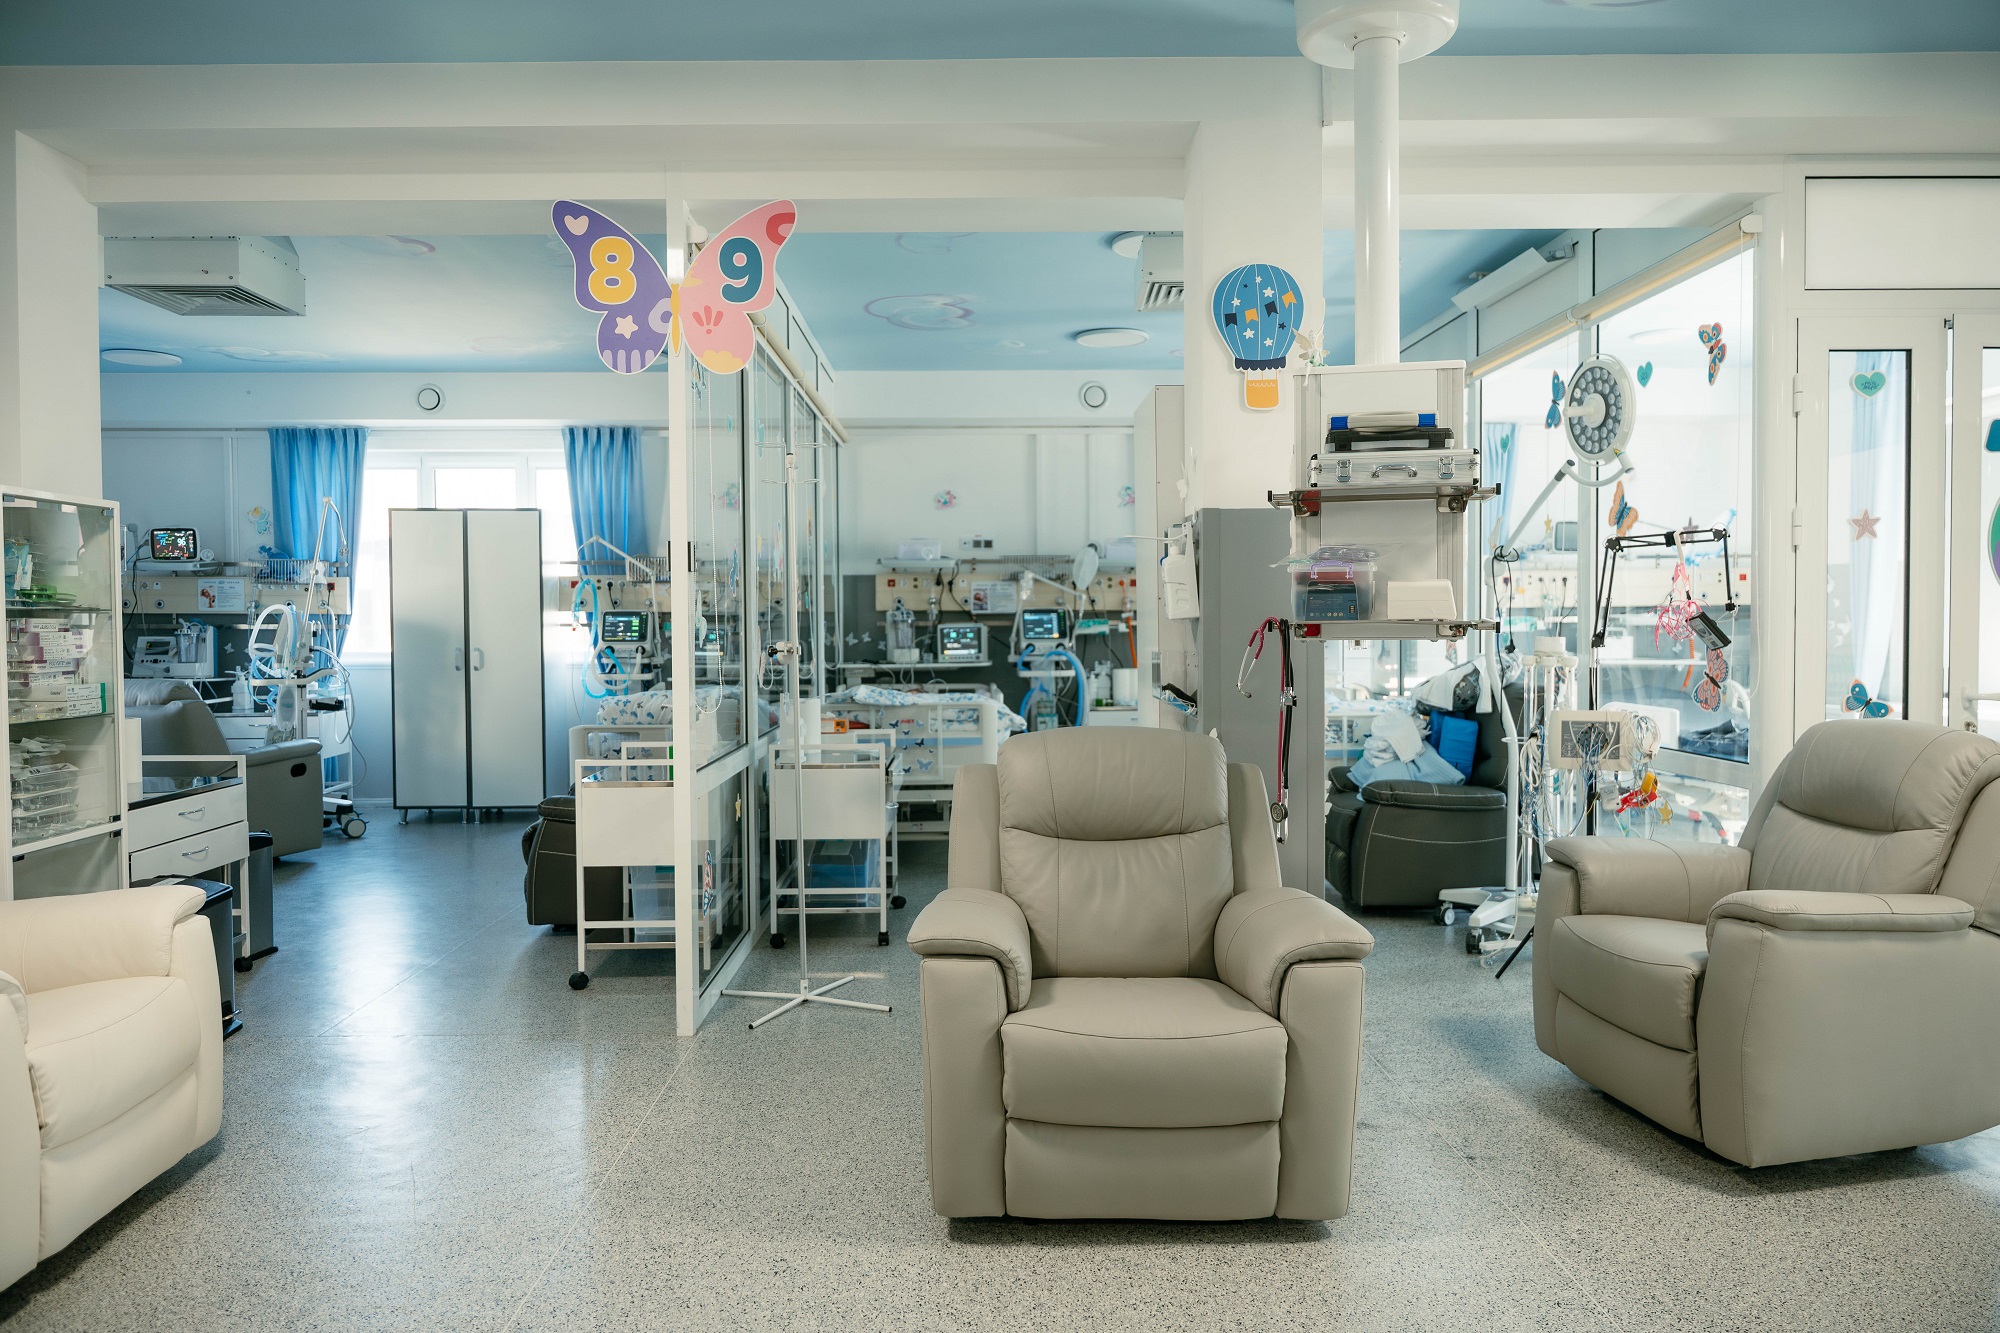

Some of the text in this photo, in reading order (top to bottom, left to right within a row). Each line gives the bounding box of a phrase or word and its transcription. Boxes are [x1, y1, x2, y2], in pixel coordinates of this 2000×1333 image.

[588, 236, 637, 305] 8
[718, 236, 764, 304] 9
[177, 537, 186, 546] 96
